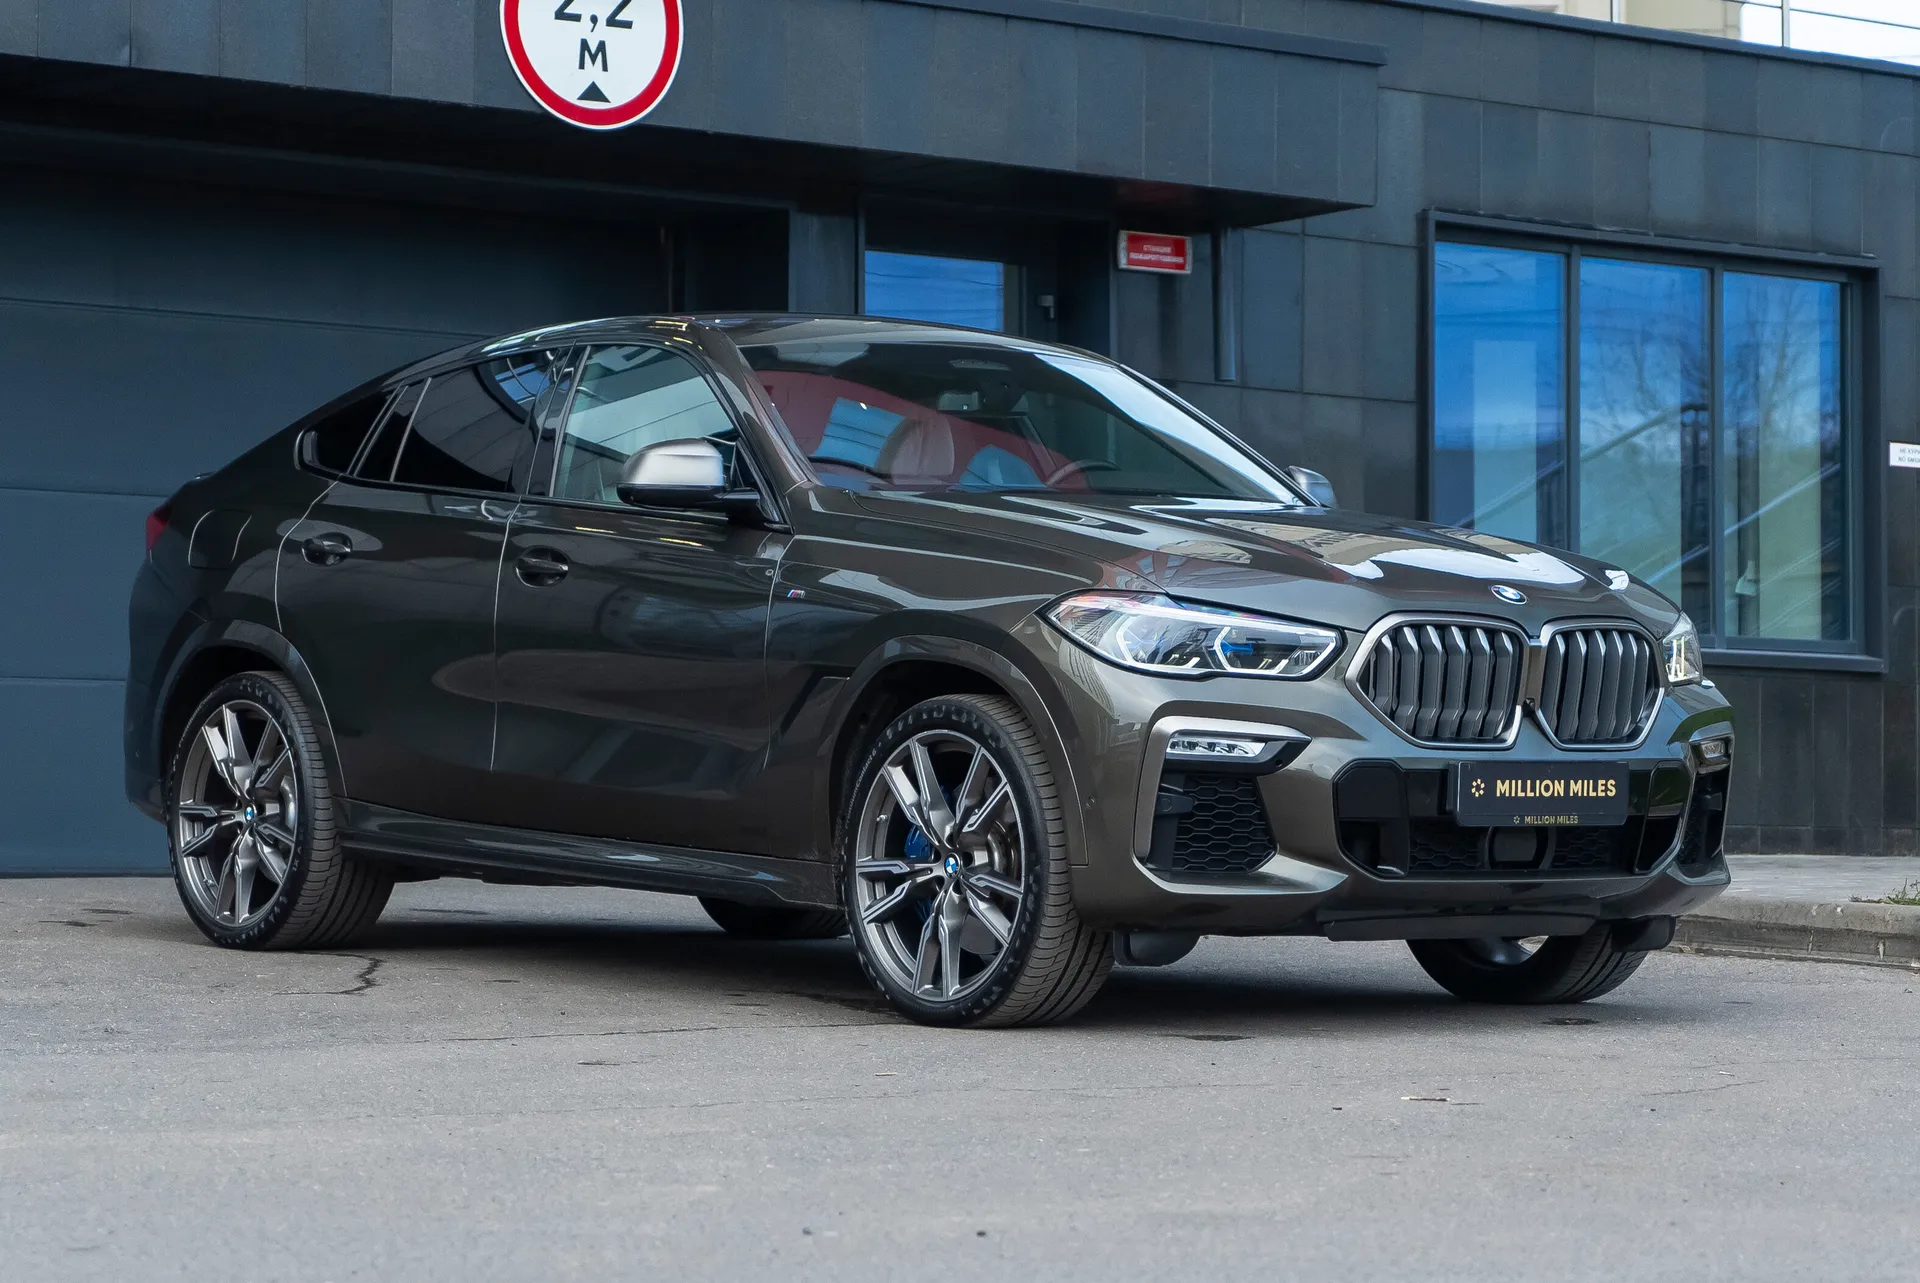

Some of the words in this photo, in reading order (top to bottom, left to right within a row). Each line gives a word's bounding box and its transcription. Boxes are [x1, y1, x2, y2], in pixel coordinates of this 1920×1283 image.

[1496, 779, 1565, 797] MILLION
[1569, 779, 1617, 797] MILES
[1524, 815, 1556, 825] MILLION
[1556, 815, 1579, 825] MILES
